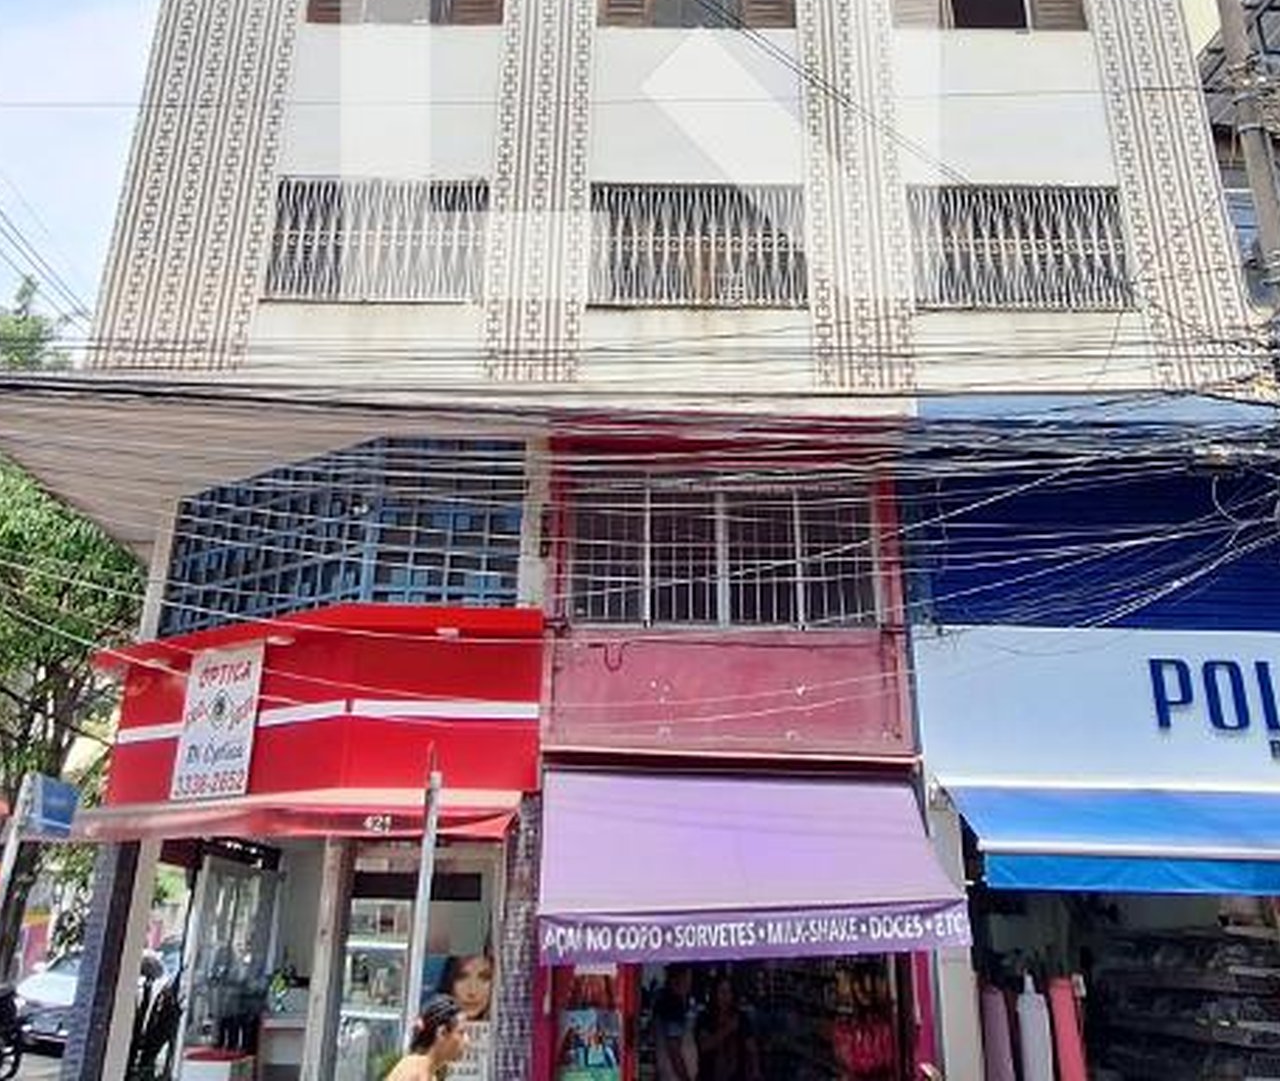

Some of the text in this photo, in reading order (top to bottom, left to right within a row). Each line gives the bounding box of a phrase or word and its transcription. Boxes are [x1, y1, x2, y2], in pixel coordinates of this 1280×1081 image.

[586, 926, 612, 951] NO
[615, 925, 662, 951] COPO
[674, 921, 756, 948] SORVETES
[870, 914, 924, 940] DOCES
